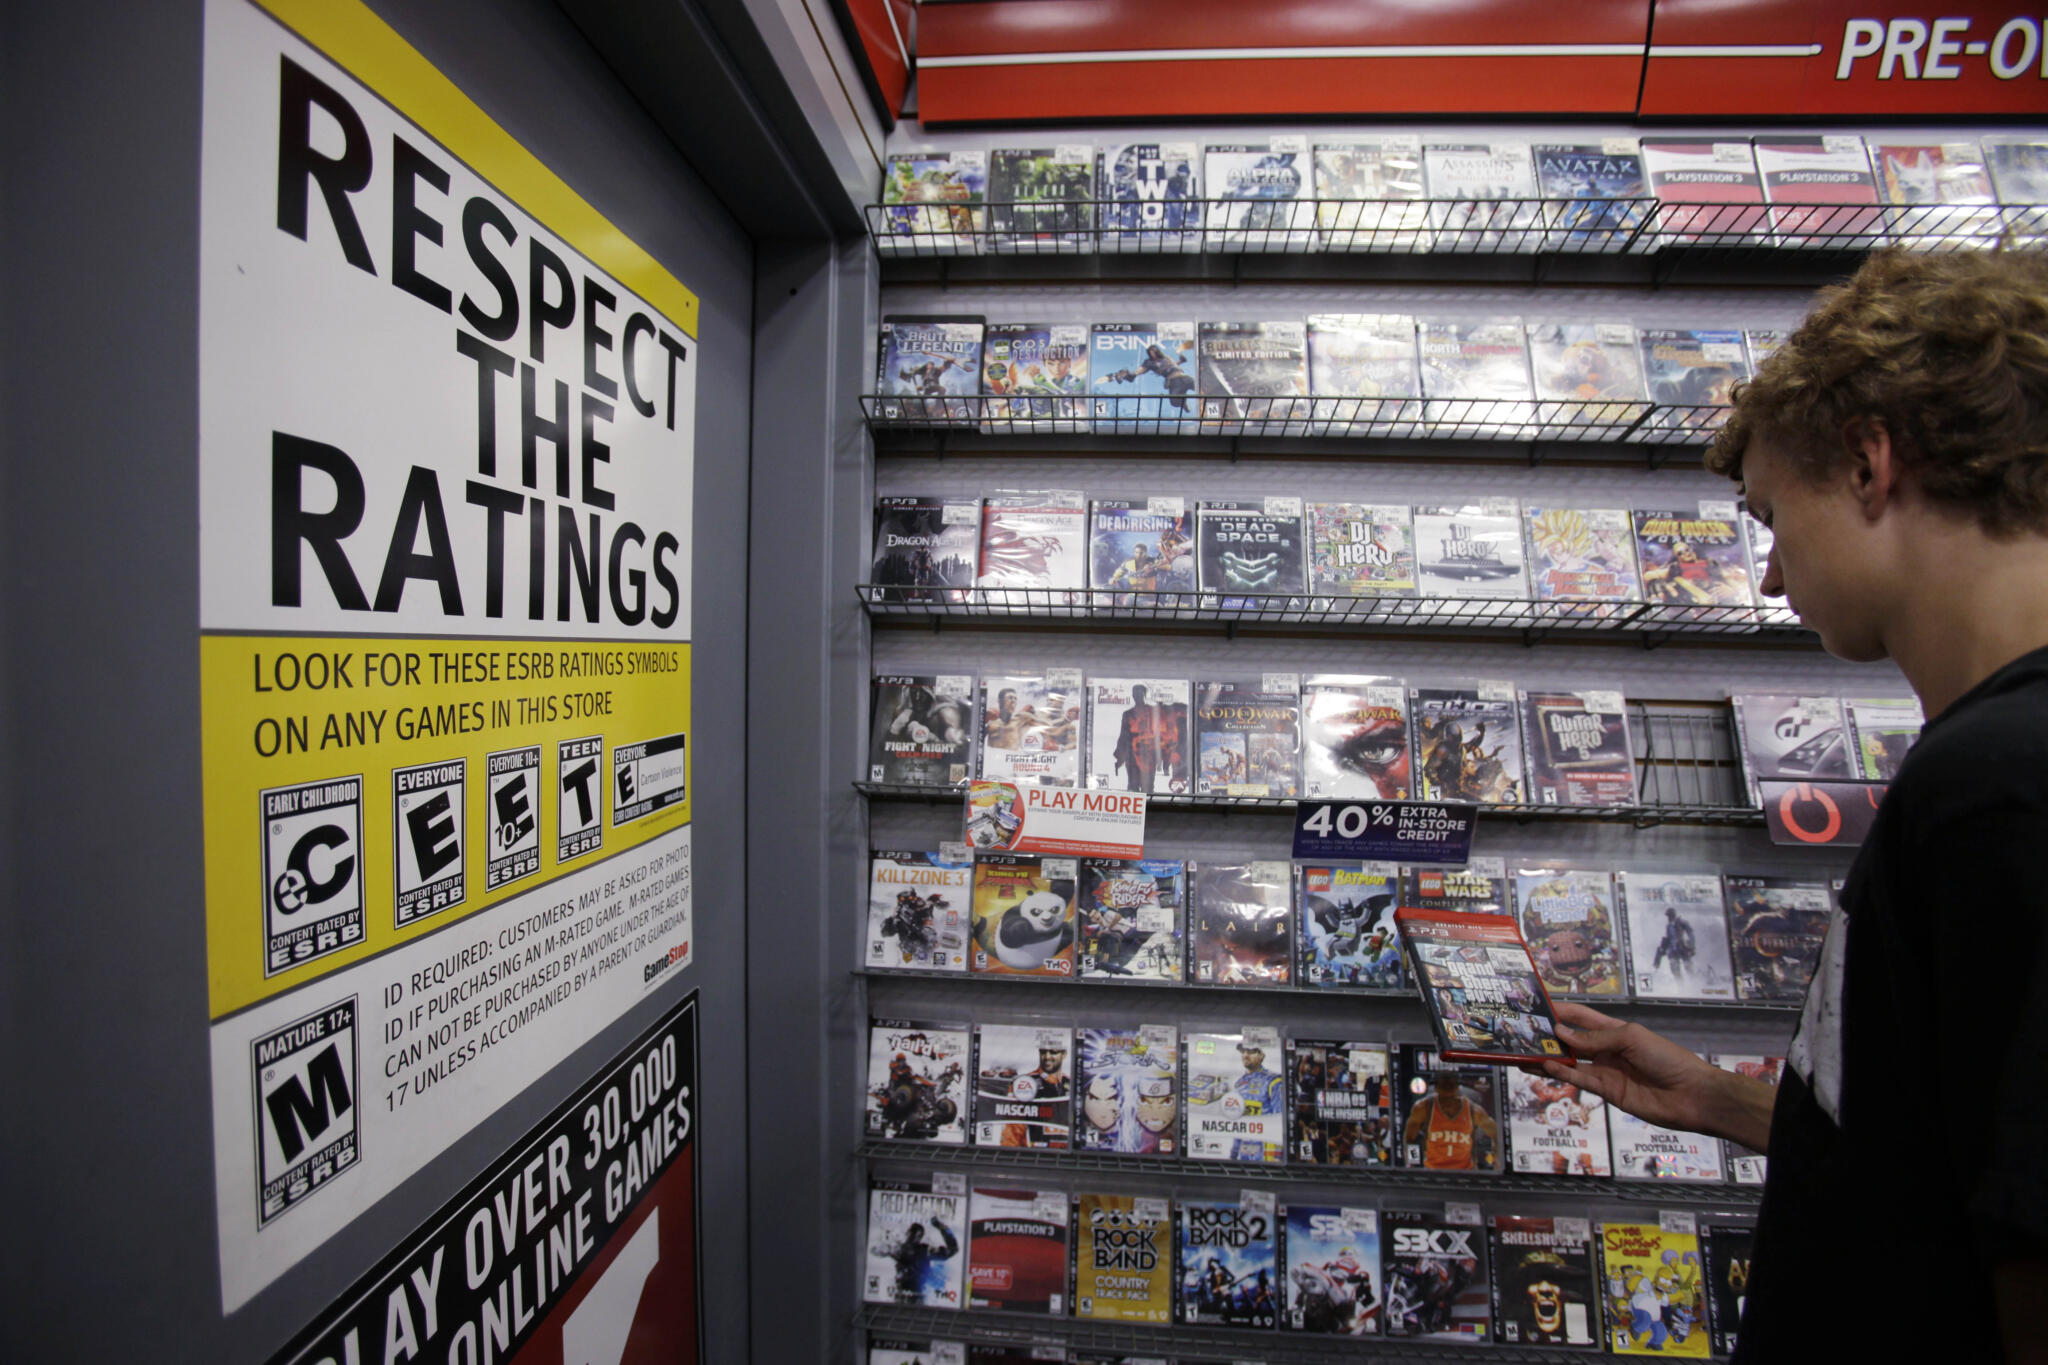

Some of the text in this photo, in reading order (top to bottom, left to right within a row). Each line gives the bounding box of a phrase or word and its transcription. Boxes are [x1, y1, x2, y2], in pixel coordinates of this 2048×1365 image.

[1836, 18, 2048, 80] PRE-O
[1543, 157, 1638, 175] AVATAR
[1665, 173, 1732, 183] PLAYSTATION
[1779, 172, 1848, 183] PLAYSTATION
[277, 52, 687, 432] RESPECT
[902, 341, 965, 353] LEGEND
[1096, 335, 1166, 350] BRINK
[456, 328, 616, 512] THE
[272, 430, 680, 630] RATINGS
[1215, 532, 1280, 543] SPACE
[1220, 522, 1277, 532] DEAD
[1349, 520, 1373, 545] DJ
[886, 534, 930, 547] DRAGON
[254, 651, 678, 692] LOOK FOR THESE ESRB RATINGS SYMBOLS
[254, 691, 613, 757] ON ANY GAMES IN THIS STORE
[561, 740, 600, 758] TEEN
[615, 744, 647, 763] EVERYONE
[885, 741, 956, 753] FIGHT NIGHT
[490, 752, 539, 774] EVERYONE 10+
[1005, 754, 1030, 763] FIGHT
[398, 764, 463, 791] EVERYONE
[617, 763, 635, 805] E
[267, 782, 358, 816] EARLY CHILDHOOD
[562, 757, 597, 827] T
[1028, 789, 1144, 814] PLAY MORE
[494, 772, 535, 851] E
[1302, 804, 1448, 839] 40% EXTRA
[1399, 818, 1467, 831] IN-STORE
[406, 790, 460, 883] E
[560, 835, 600, 858] ESRB
[1397, 830, 1451, 842] CREDIT
[489, 851, 530, 872] CONTENT RATED
[489, 859, 538, 886] ESRB
[876, 868, 949, 886] KILLZONE
[955, 871, 965, 886] 3
[1309, 875, 1330, 886] LEGO
[1334, 869, 1389, 887] BATMAN
[1421, 873, 1492, 890] LEGO STAR
[399, 876, 463, 906] CONTENT RATED BY
[1110, 892, 1149, 906] RIDER
[1444, 885, 1493, 898] WARS
[399, 886, 463, 922] ESRB
[270, 910, 360, 951] CONTENT RATED BY
[385, 844, 689, 1009] ID REQUIRED: CUSTOMERS MAY BE ASKED FOR PHOTO
[271, 922, 361, 969] ESRB
[385, 865, 689, 1044] ID IF PURCHASING AN M-RATED GAME. M-RATED GAMES
[644, 941, 688, 982] GameStop
[1045, 959, 1071, 973] THQ
[385, 886, 689, 1078] CAN NOT BE PURCHASED BY ANYONE UNDER THE AGE OF
[386, 908, 687, 1112] 17 UNLESS ACCOMPANIED BY A PARENT OR GUARDIAN.
[260, 1009, 351, 1066] MATURE 17+
[265, 1041, 352, 1165] M
[995, 1103, 1038, 1117] NASCAR
[1325, 1092, 1350, 1107] NBA
[1318, 1107, 1368, 1121] THE INSIDE
[1202, 1120, 1264, 1134] NASCAR 09
[1430, 1131, 1471, 1144] PHX
[1547, 1128, 1572, 1139] NCAA
[1533, 1137, 1577, 1148] FOOTBALL
[1634, 1144, 1698, 1154] FOOTBALL 11
[1650, 1134, 1680, 1144] NCAA
[264, 1133, 355, 1201] CONTENT RATED BY
[264, 1146, 355, 1219] ESRB
[314, 1034, 677, 1365] LAY OVER 30,000
[881, 1192, 903, 1213] RED
[447, 1085, 691, 1365] ONLINE GAMES
[984, 1221, 1055, 1236] PLAYSTATION 3
[1189, 1207, 1250, 1232] ROCK
[1250, 1216, 1268, 1241] 2
[1093, 1228, 1158, 1253] ROCK
[1189, 1229, 1249, 1248] BAND
[1094, 1249, 1157, 1271] BAND
[971, 1267, 995, 1277] SAVE
[1095, 1275, 1150, 1290] COUNTRY
[1095, 1289, 1149, 1300] TRACK PACK
